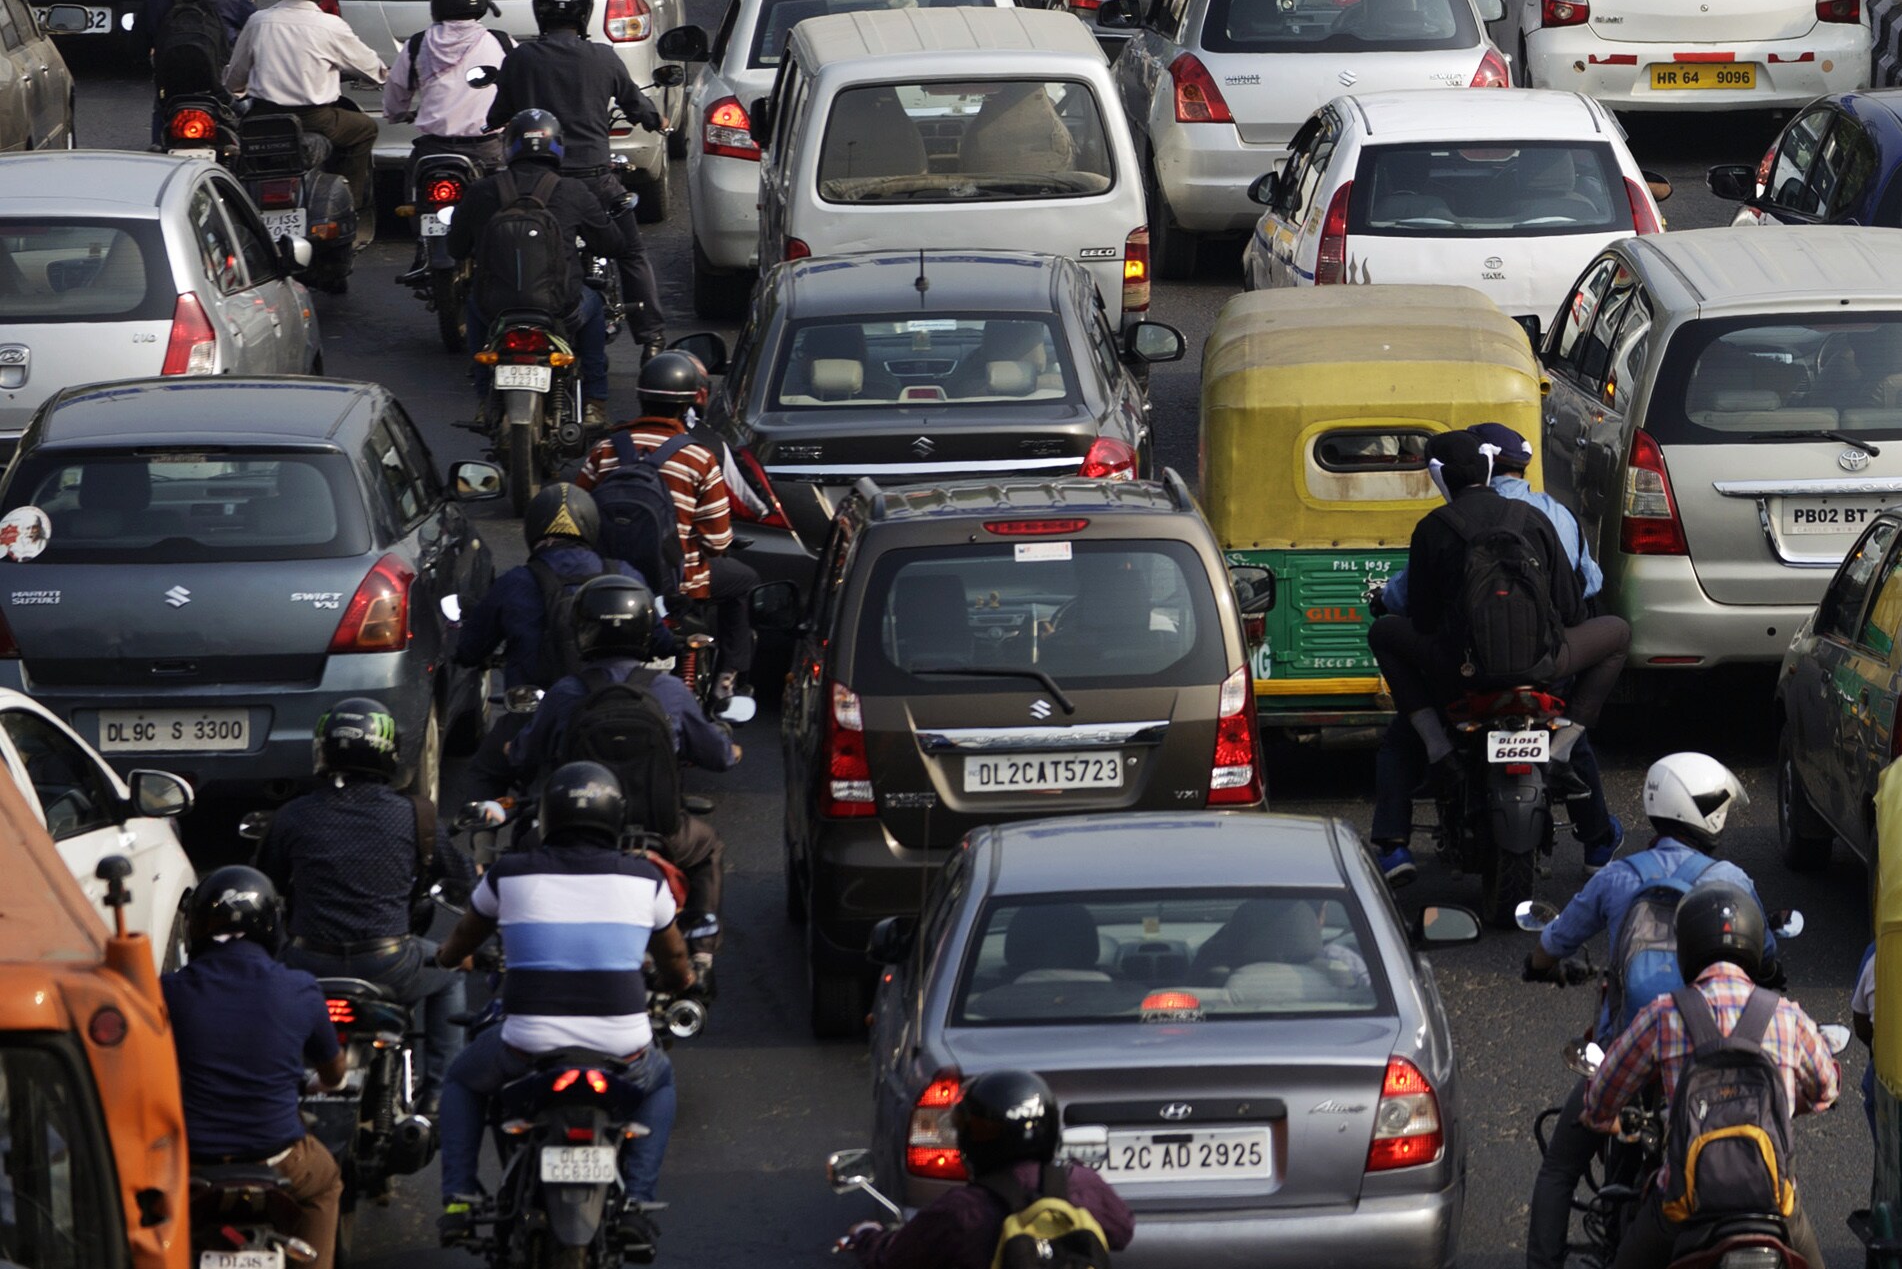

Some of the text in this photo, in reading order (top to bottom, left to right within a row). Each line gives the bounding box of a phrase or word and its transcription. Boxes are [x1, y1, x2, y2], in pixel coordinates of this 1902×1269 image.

[1656, 71, 1751, 85] HR 64 9096
[1081, 249, 1115, 257] EECO
[1793, 509, 1865, 523] PB02 BT
[291, 592, 343, 601] SWIFT
[1305, 607, 1362, 623] GILL
[107, 720, 243, 743] DL9C S 3300
[1494, 746, 1542, 759] 6660
[979, 759, 1119, 787] DL2CAT5723
[1162, 1144, 1192, 1169] AD
[1200, 1142, 1262, 1168] 2925
